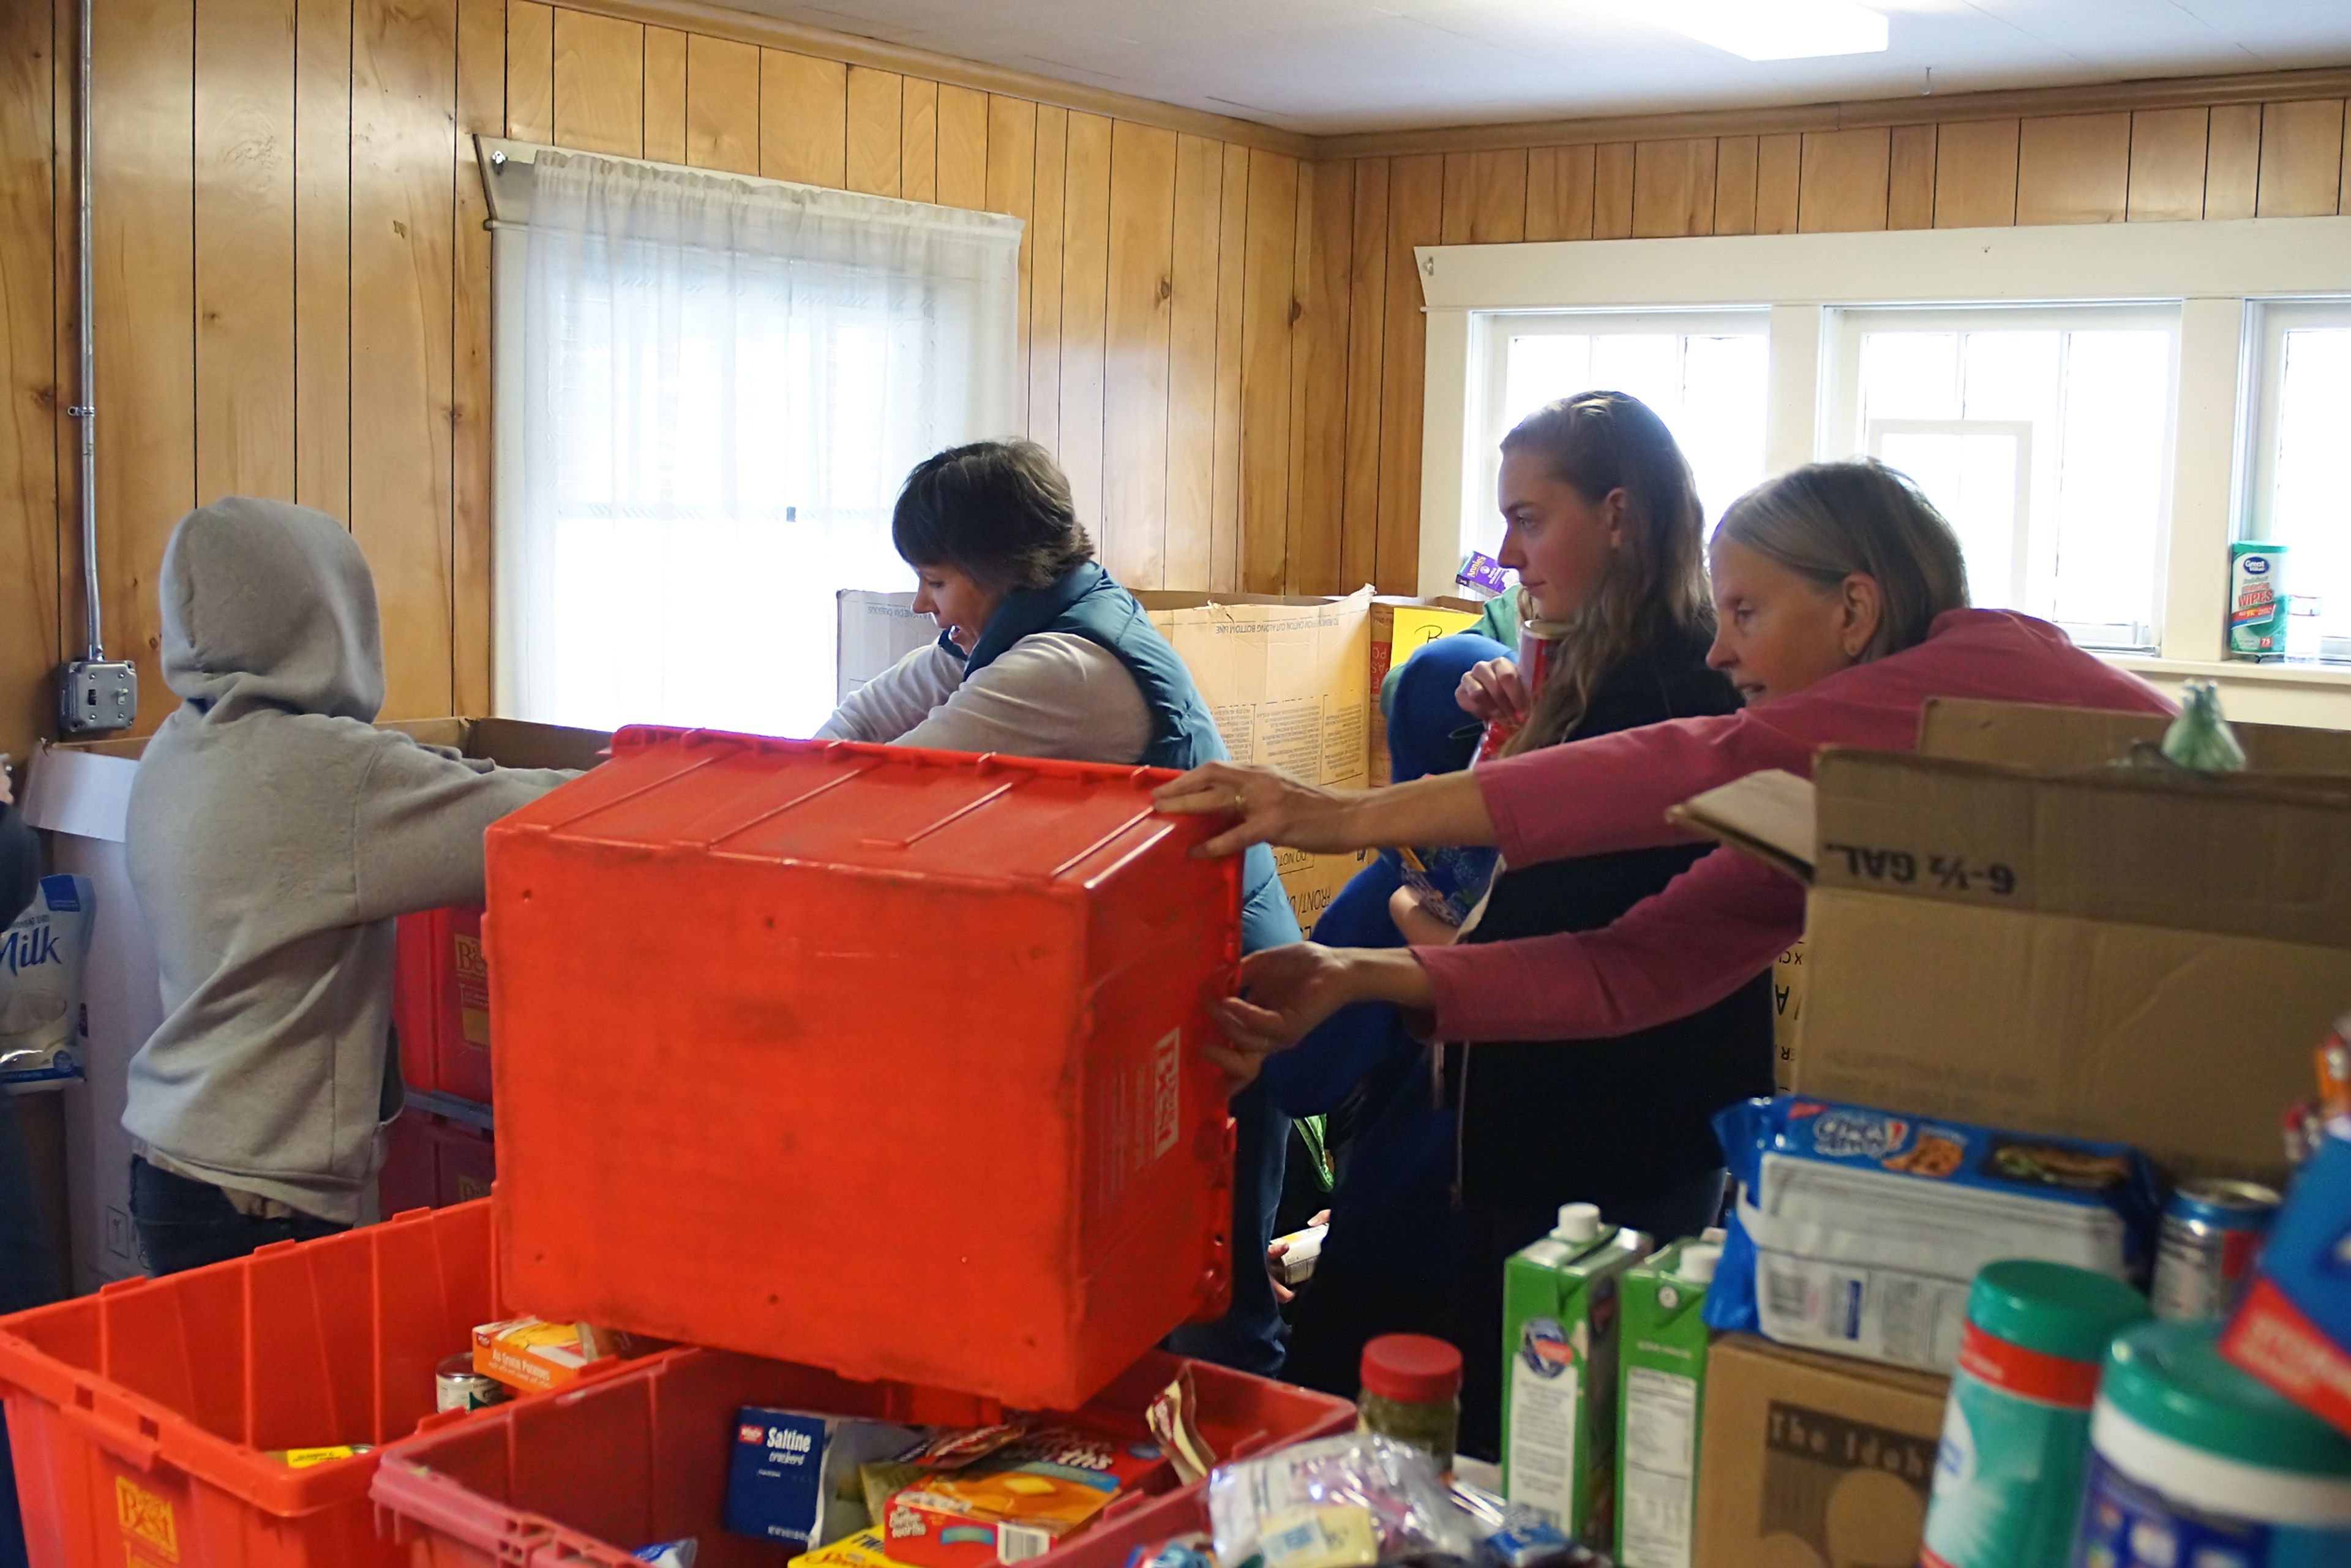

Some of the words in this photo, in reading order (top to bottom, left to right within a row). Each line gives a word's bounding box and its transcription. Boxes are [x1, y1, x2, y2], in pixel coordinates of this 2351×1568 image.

[2238, 588, 2273, 607] WIPES
[1229, 625, 1256, 633] BOTTOM
[1279, 853, 1294, 867] NOT
[767, 1426, 812, 1453] Saltine
